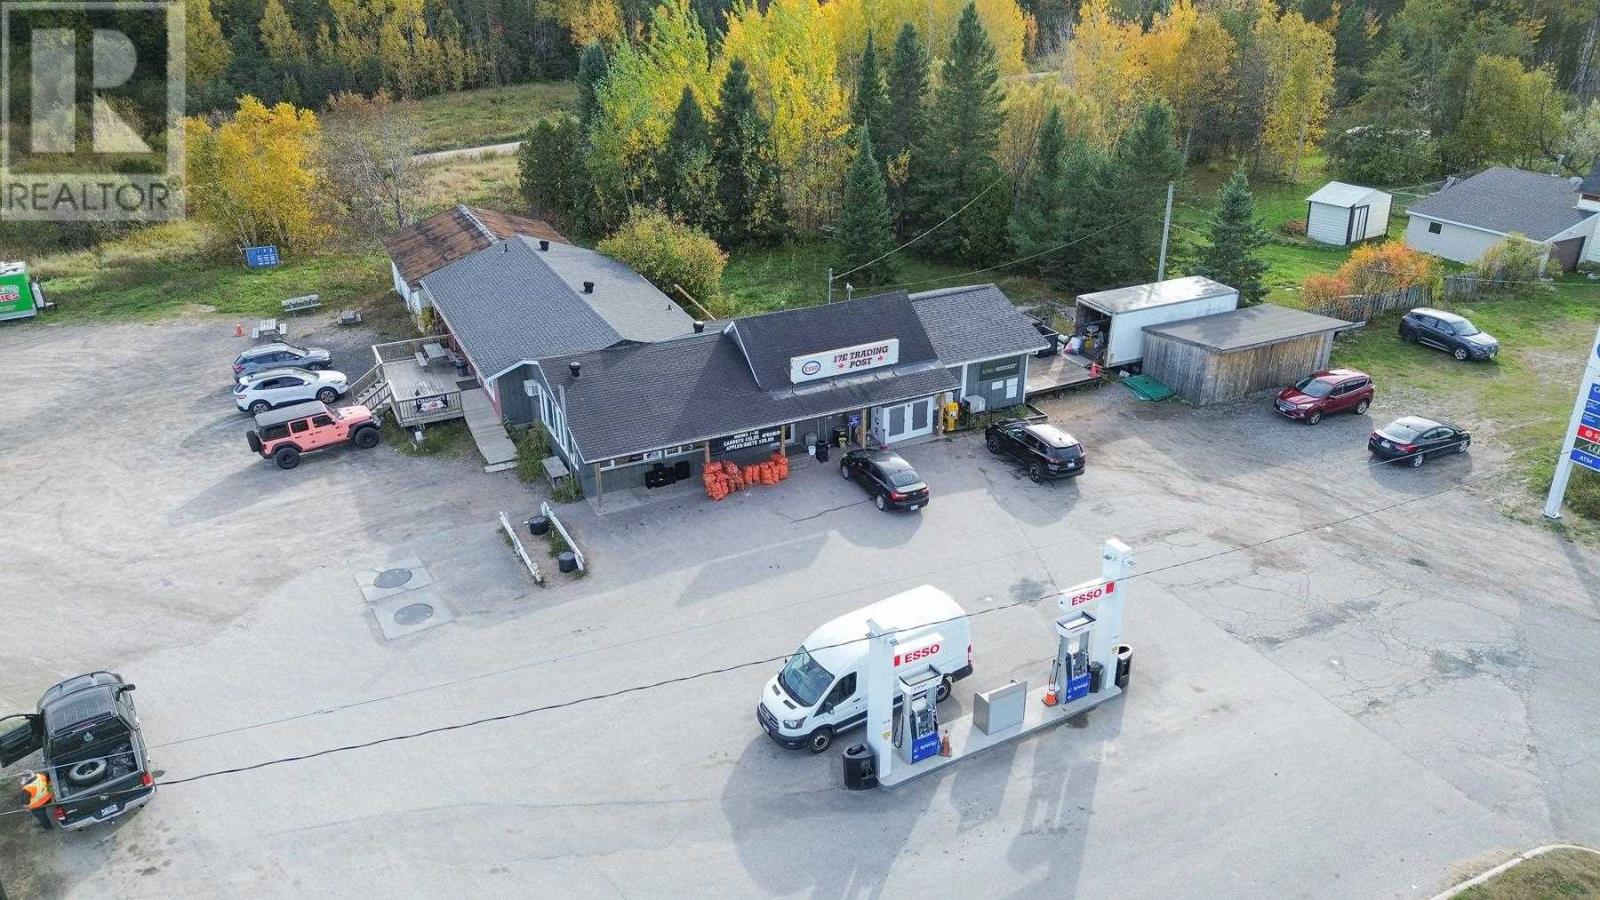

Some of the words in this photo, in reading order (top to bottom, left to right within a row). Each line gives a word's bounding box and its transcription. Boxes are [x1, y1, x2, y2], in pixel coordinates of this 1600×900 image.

[850, 345, 888, 361] TRADING
[849, 357, 872, 368] POST
[1579, 455, 1593, 464] ATM
[1071, 589, 1102, 606] ESSO
[904, 644, 940, 663] ESSO
